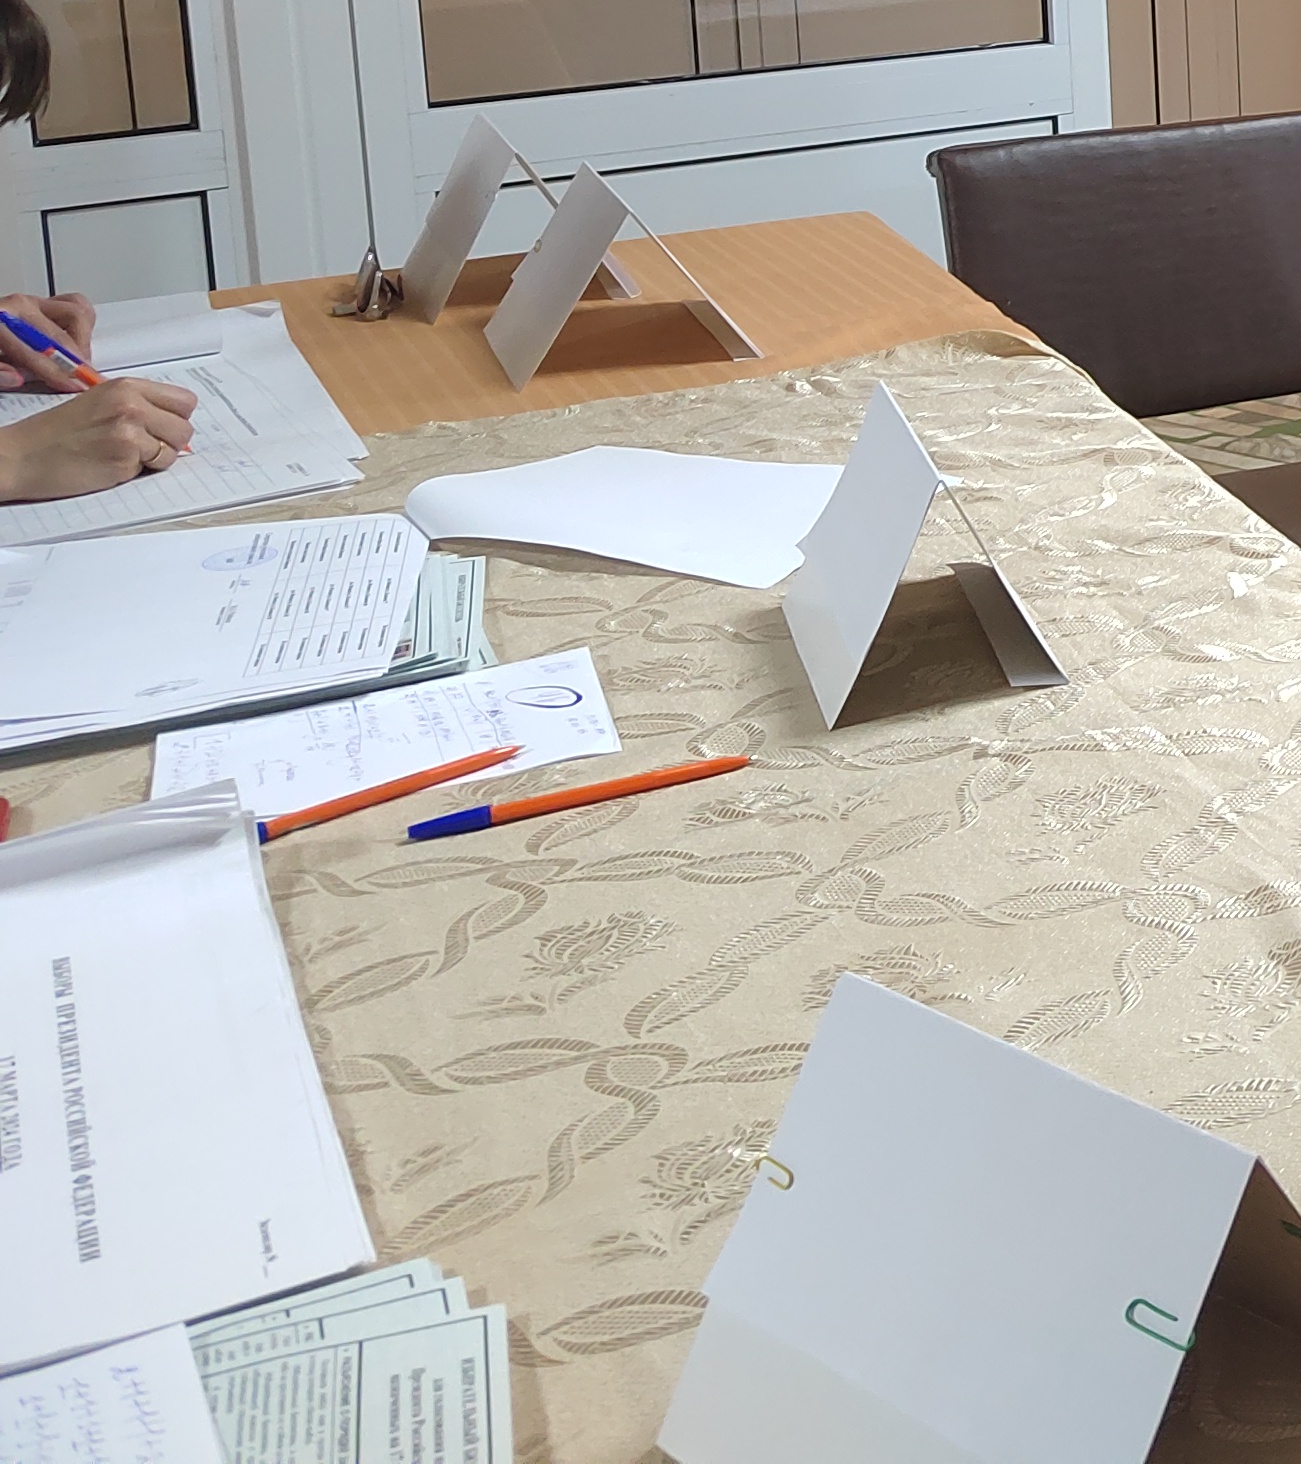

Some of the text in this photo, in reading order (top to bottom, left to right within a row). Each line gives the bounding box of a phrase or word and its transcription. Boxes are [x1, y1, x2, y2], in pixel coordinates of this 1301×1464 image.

[52, 956, 102, 1264] ВЫБОРЫ ПРЕЗИДЕНТА РОССИЙСКОЙ ФЕДЕРАЦИИ
